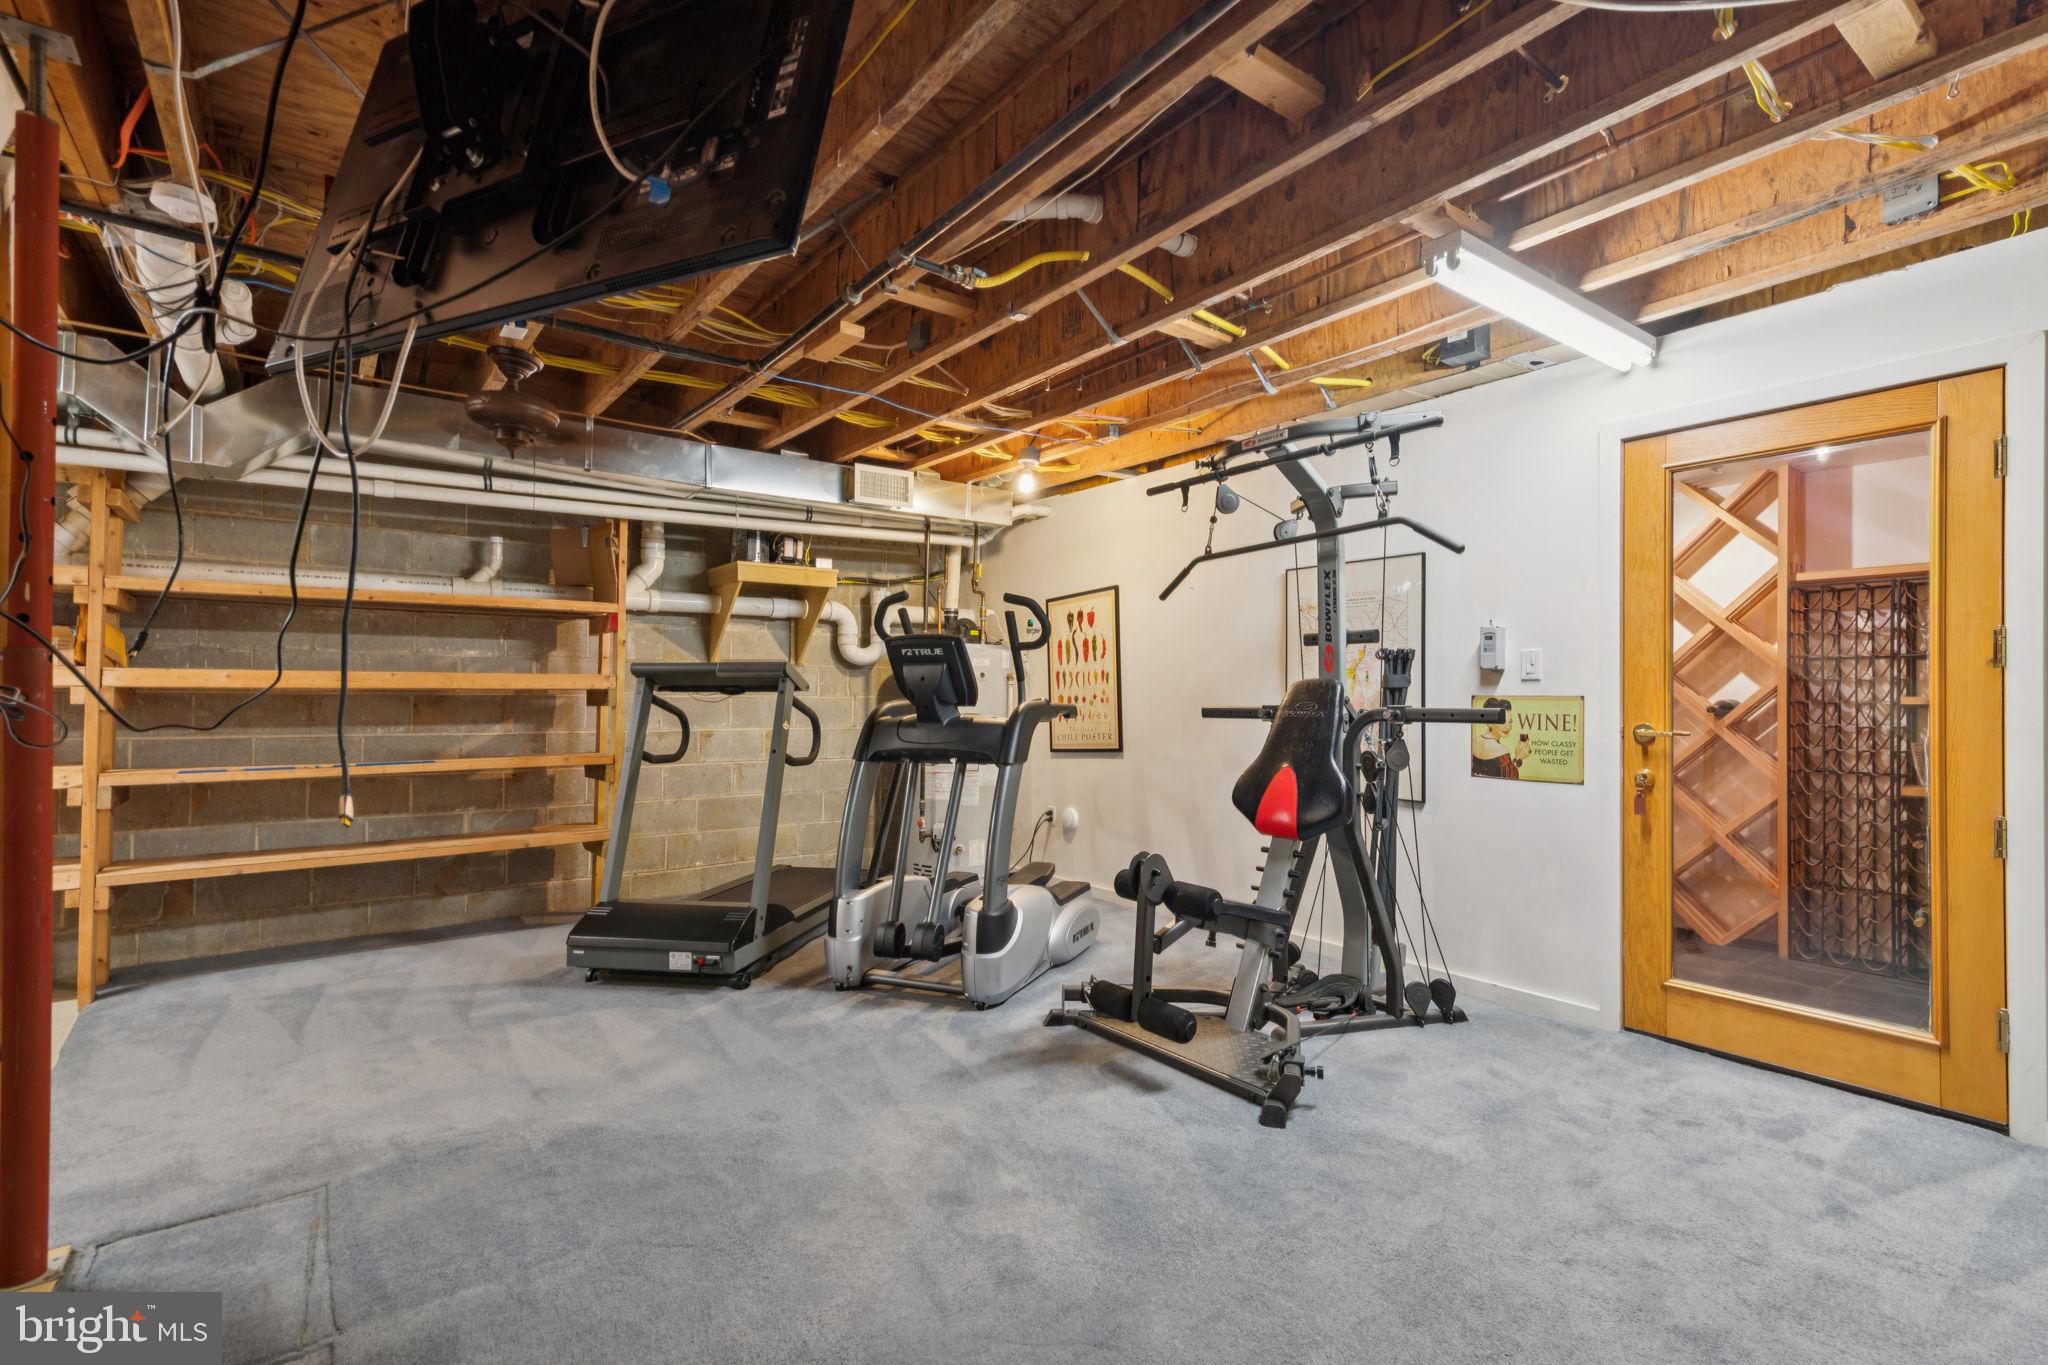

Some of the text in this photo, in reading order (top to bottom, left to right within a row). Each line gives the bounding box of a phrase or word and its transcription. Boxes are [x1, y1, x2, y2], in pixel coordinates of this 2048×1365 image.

[1324, 568, 1333, 643] BOWFLEX
[912, 648, 944, 656] TRUE
[1517, 713, 1577, 732] WINE!
[1057, 732, 1113, 741] CHILE POSTER
[1551, 740, 1577, 748] CLASSY
[1540, 758, 1568, 766] WASTED
